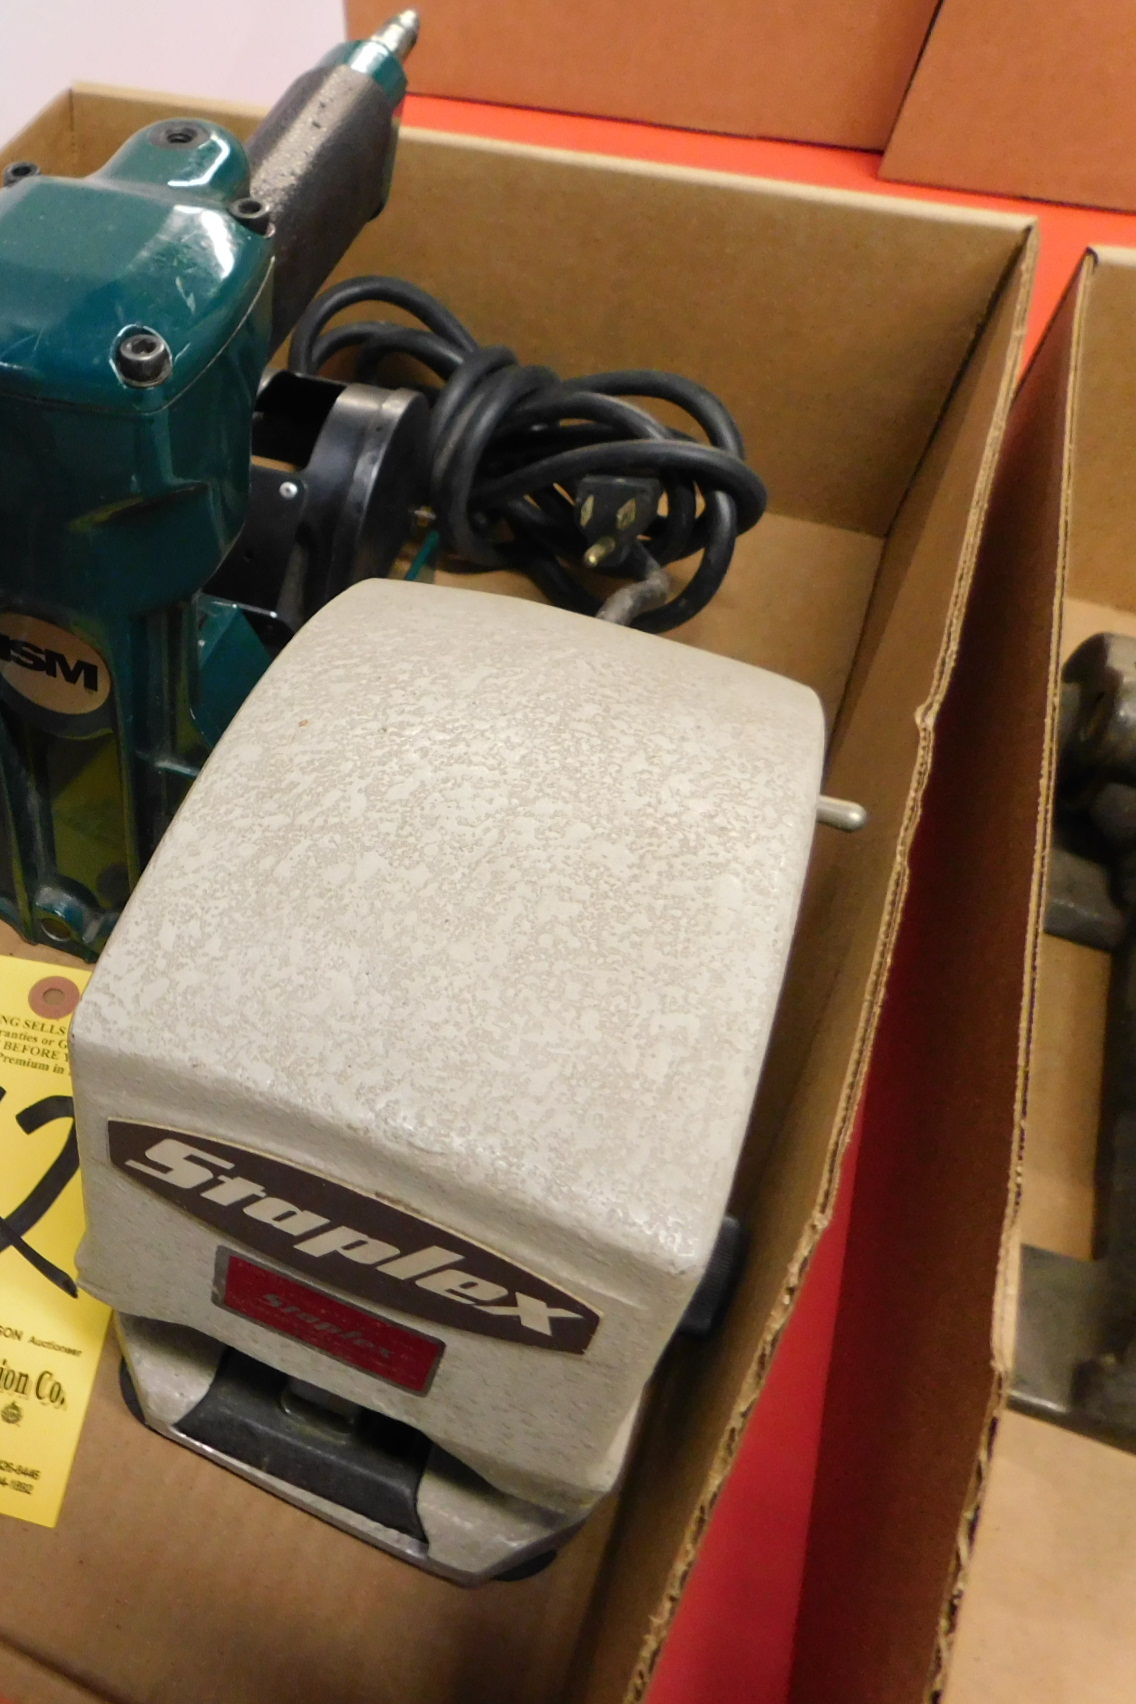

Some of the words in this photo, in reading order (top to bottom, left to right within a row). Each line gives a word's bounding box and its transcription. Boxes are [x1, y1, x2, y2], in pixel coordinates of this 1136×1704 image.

[22, 1019, 66, 1035] SELLS
[41, 1037, 55, 1046] or
[3, 1041, 62, 1060] BEFORE
[52, 1063, 65, 1074] in
[125, 1138, 585, 1337] Staplex
